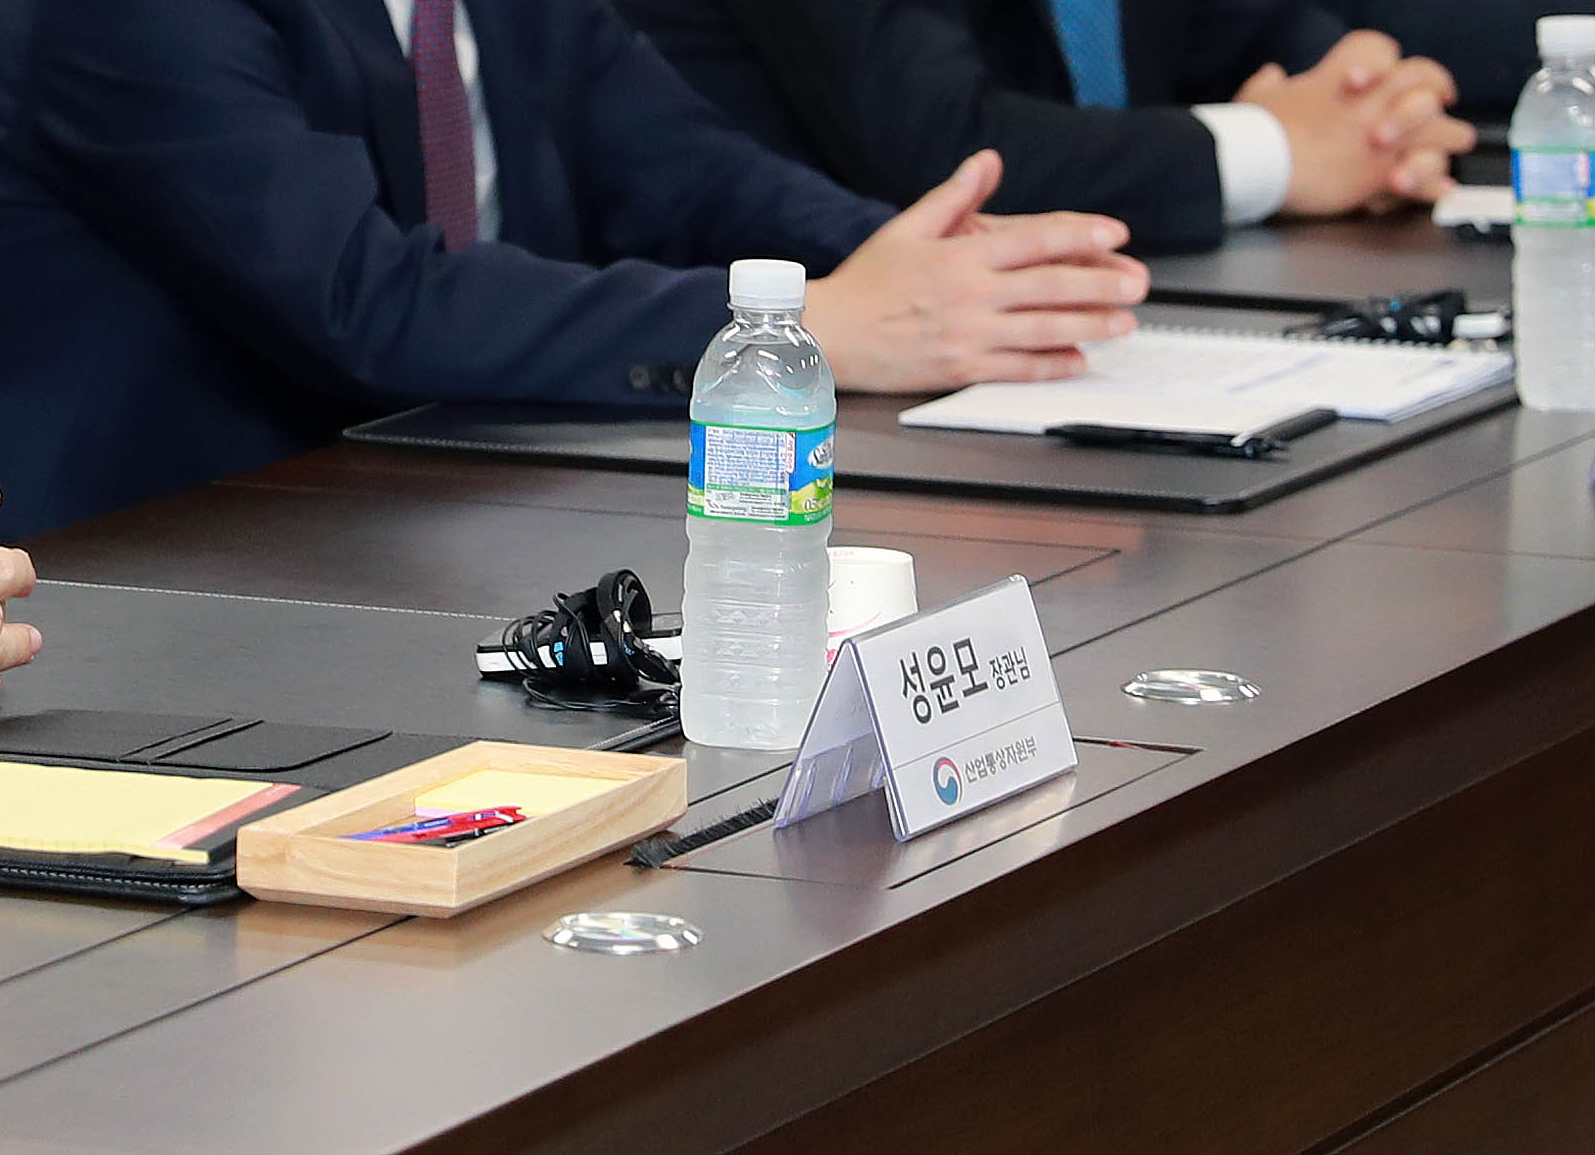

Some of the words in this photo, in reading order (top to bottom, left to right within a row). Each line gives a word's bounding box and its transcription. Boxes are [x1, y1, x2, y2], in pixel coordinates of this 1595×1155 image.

[900, 638, 989, 724] 성윤모
[989, 646, 1031, 690] 장관님
[965, 736, 1037, 783] 산업통상자원부
